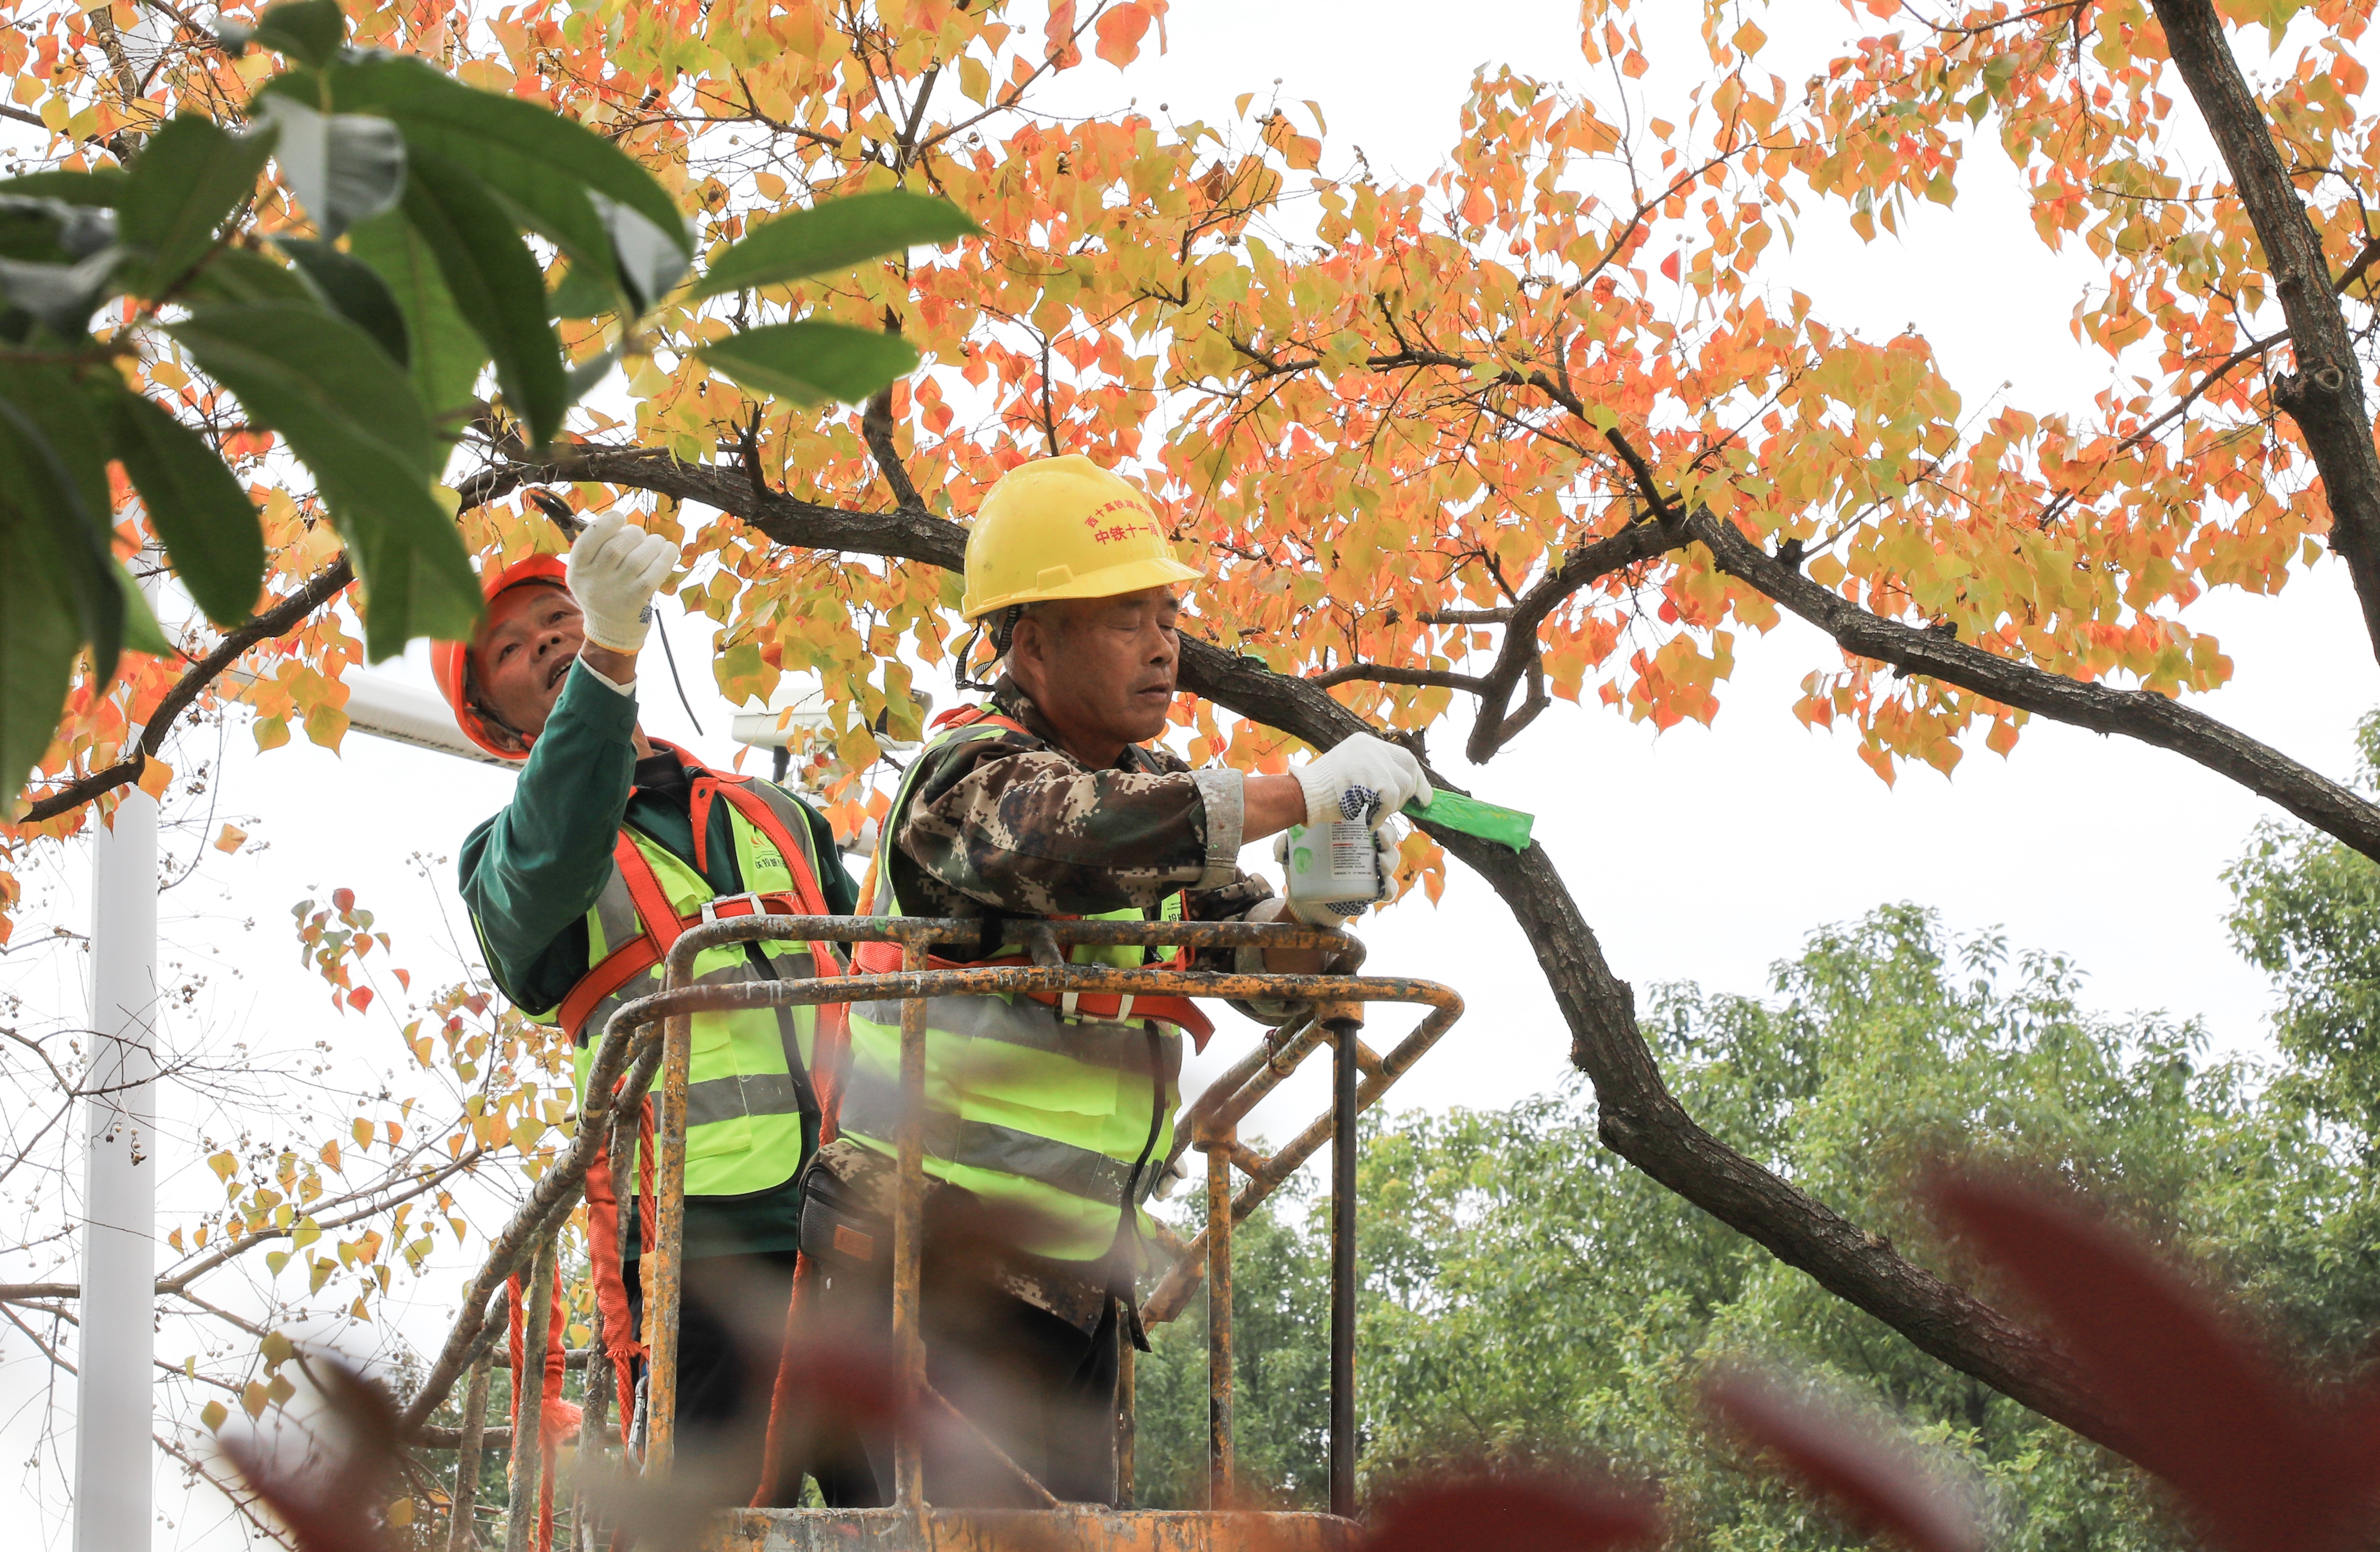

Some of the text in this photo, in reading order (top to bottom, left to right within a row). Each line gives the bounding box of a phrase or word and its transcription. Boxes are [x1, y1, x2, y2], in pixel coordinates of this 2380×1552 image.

[1095, 523, 1159, 545] 中铁十一局
